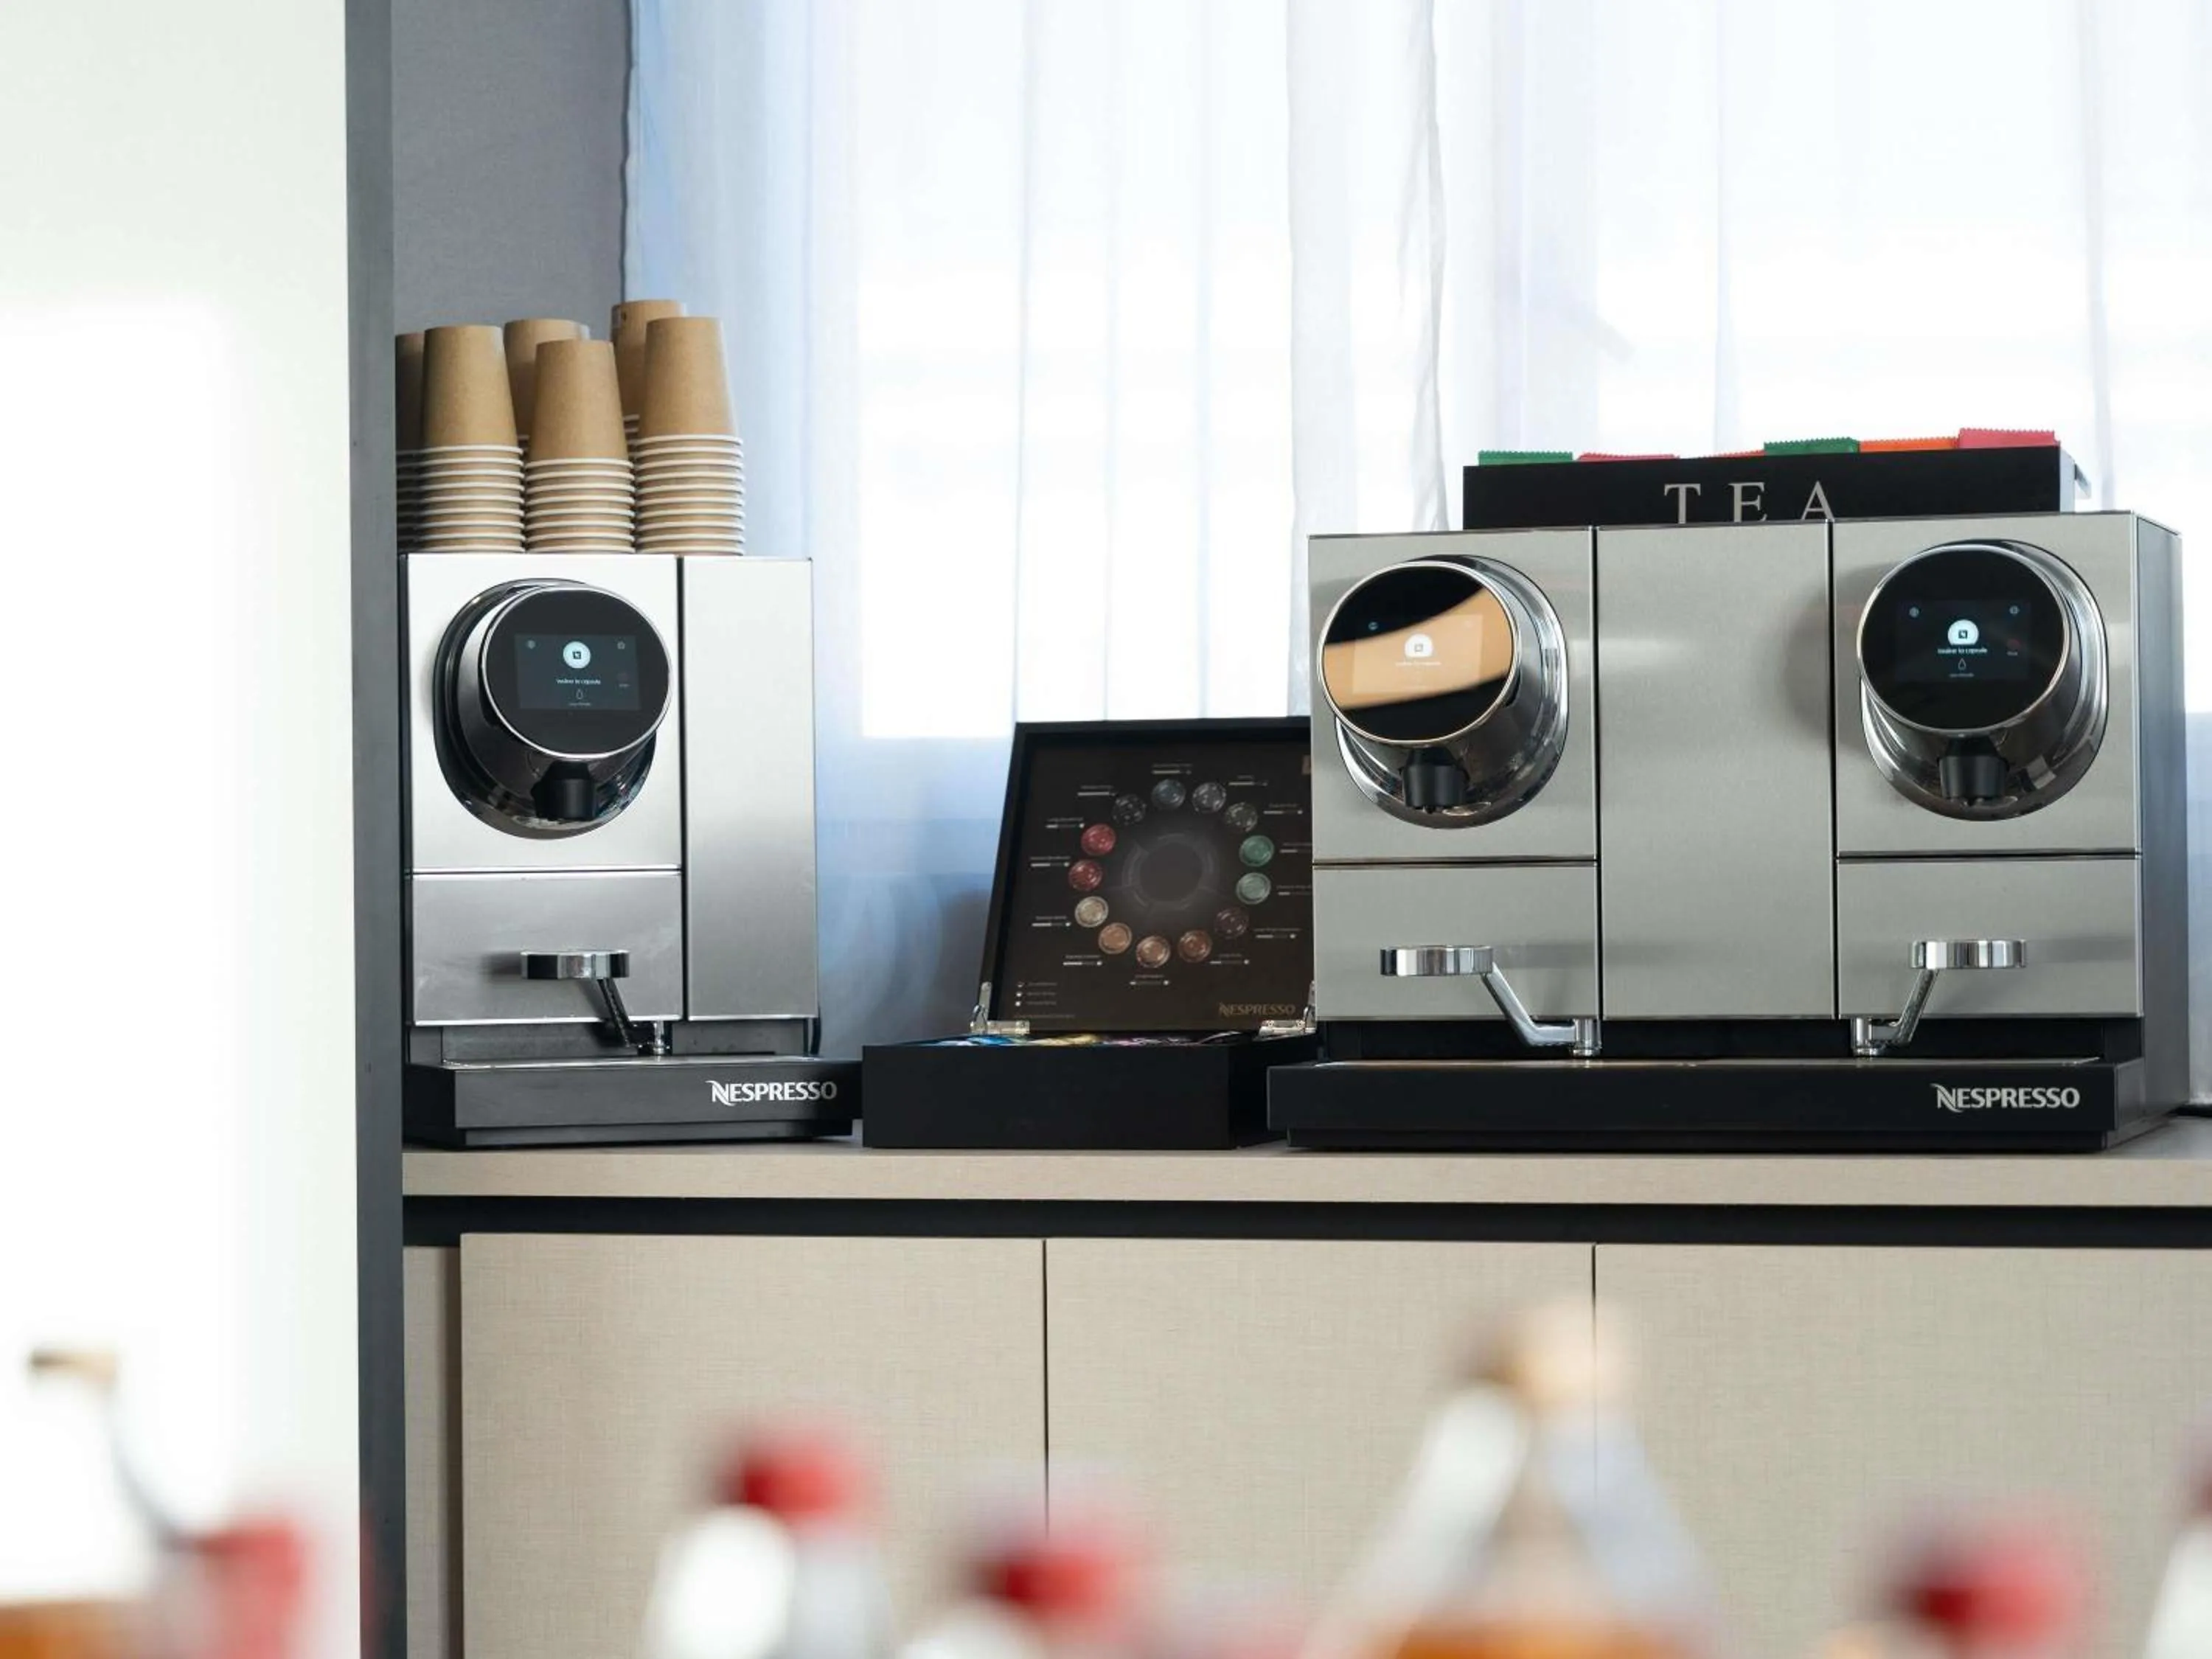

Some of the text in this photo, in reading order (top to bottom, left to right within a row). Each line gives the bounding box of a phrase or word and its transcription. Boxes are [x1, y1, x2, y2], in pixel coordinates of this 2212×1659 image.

[1663, 480, 1835, 524] TEA
[1217, 1001, 1296, 1017] NESPRESSO
[705, 1080, 838, 1106] NESPRESSO
[1930, 1082, 2080, 1113] NESPRESSO
